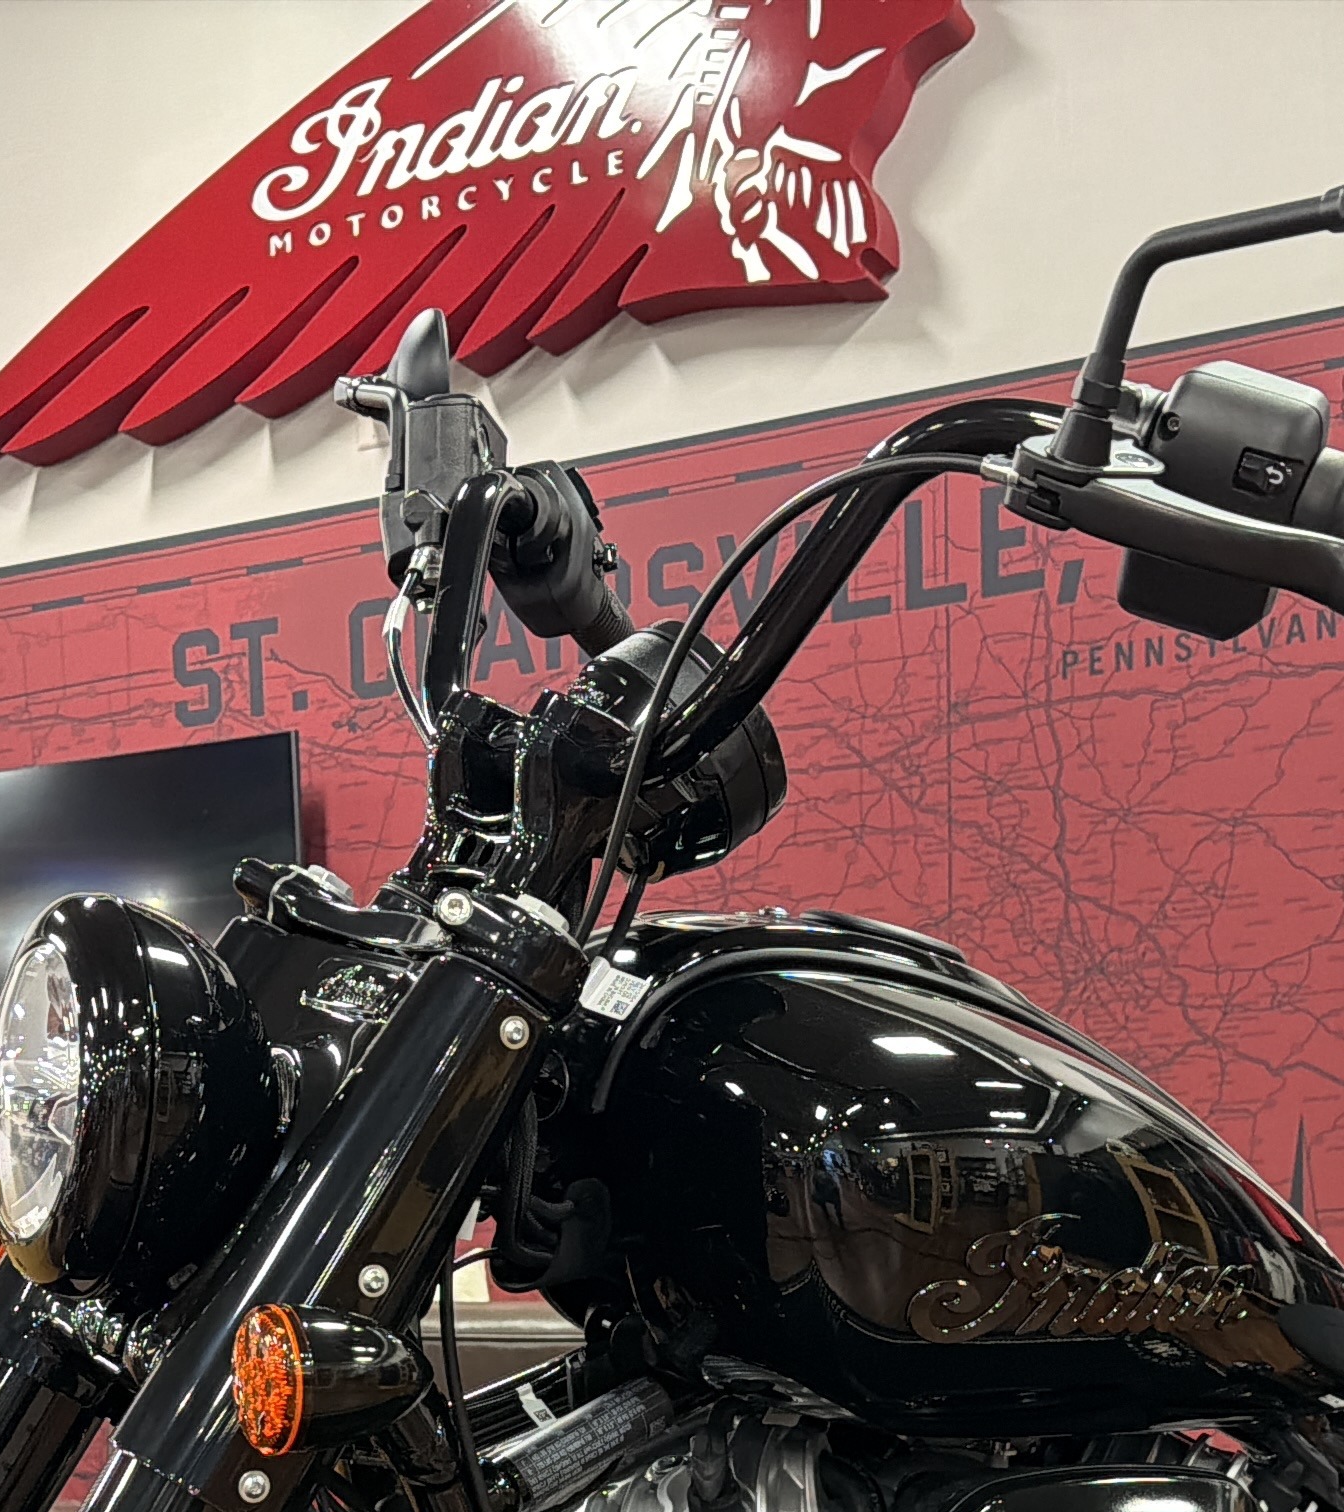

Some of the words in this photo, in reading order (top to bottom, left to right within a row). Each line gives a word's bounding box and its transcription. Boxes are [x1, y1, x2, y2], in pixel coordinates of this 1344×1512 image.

[251, 66, 639, 222] Indian
[268, 149, 625, 258] MOTORCYCLE
[170, 616, 312, 729] ST.
